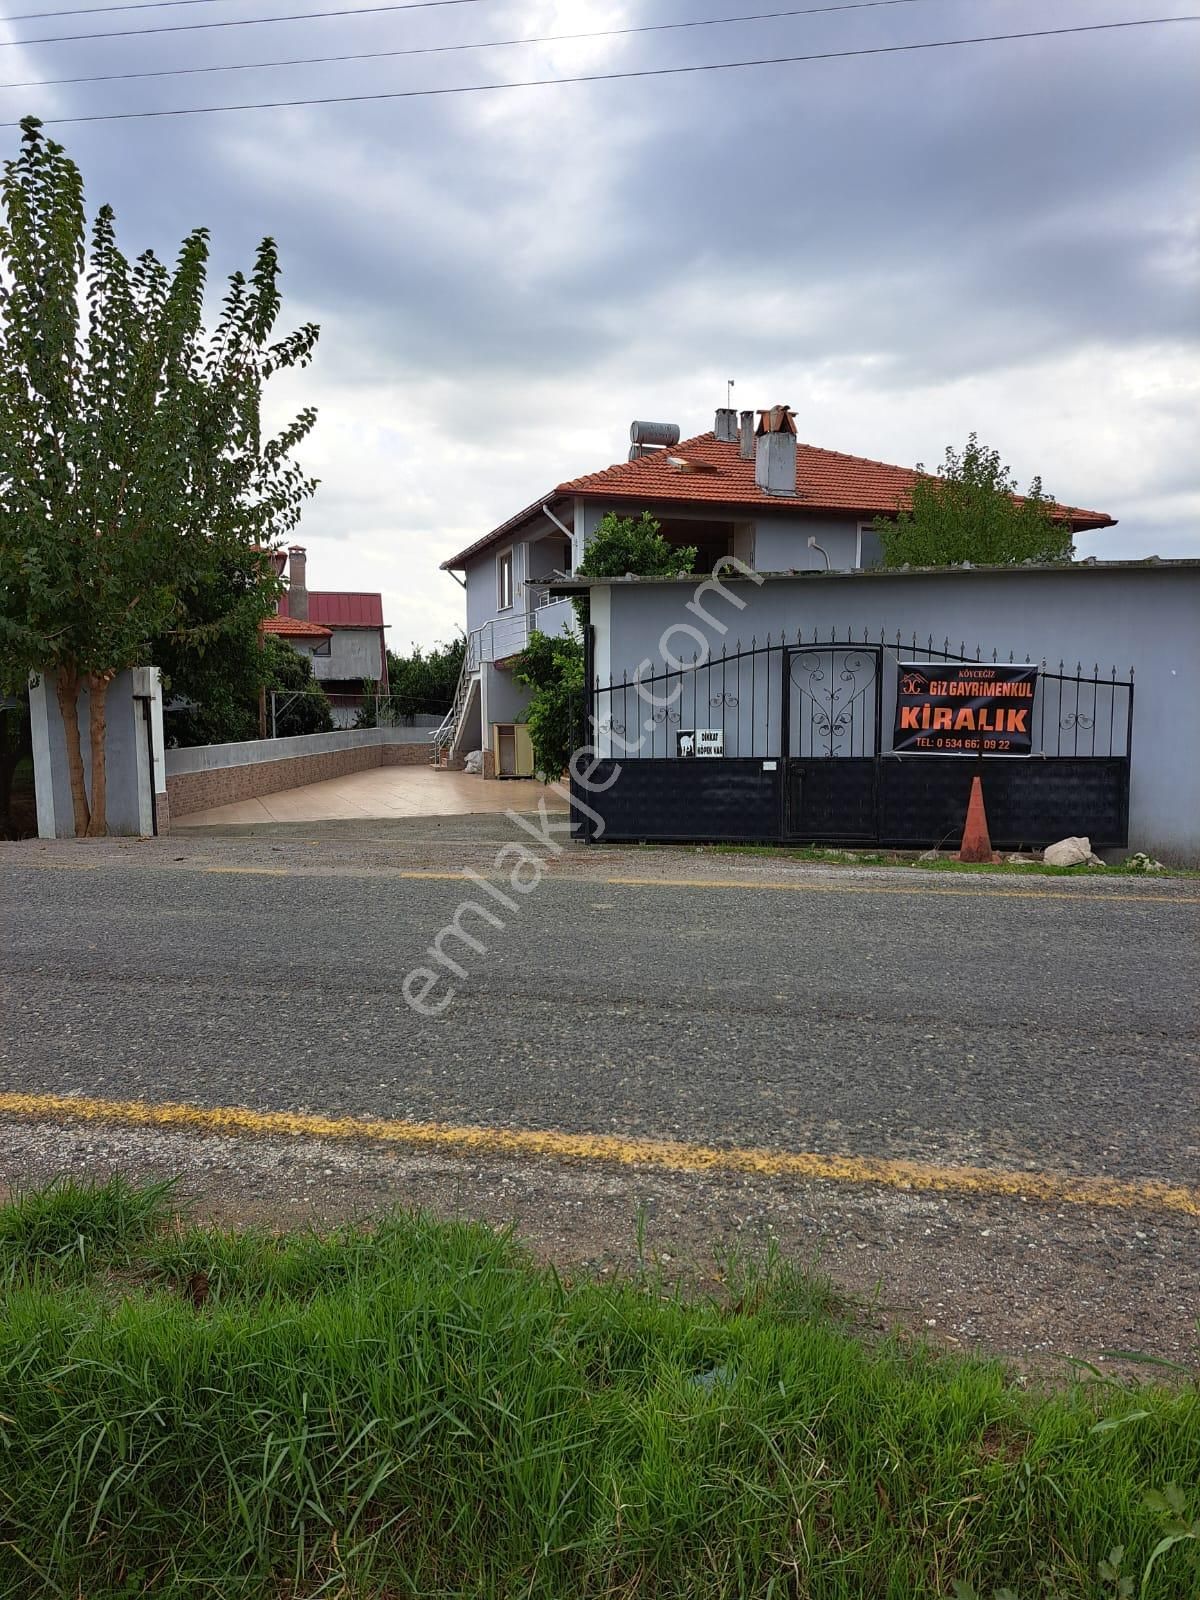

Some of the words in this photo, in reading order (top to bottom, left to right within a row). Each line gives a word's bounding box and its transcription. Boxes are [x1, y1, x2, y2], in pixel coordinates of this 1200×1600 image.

[901, 703, 1029, 731] KİRALIK
[936, 738, 943, 748] 0
[945, 738, 962, 748] 534
[983, 739, 996, 750] 09
[998, 740, 1010, 750] 22
